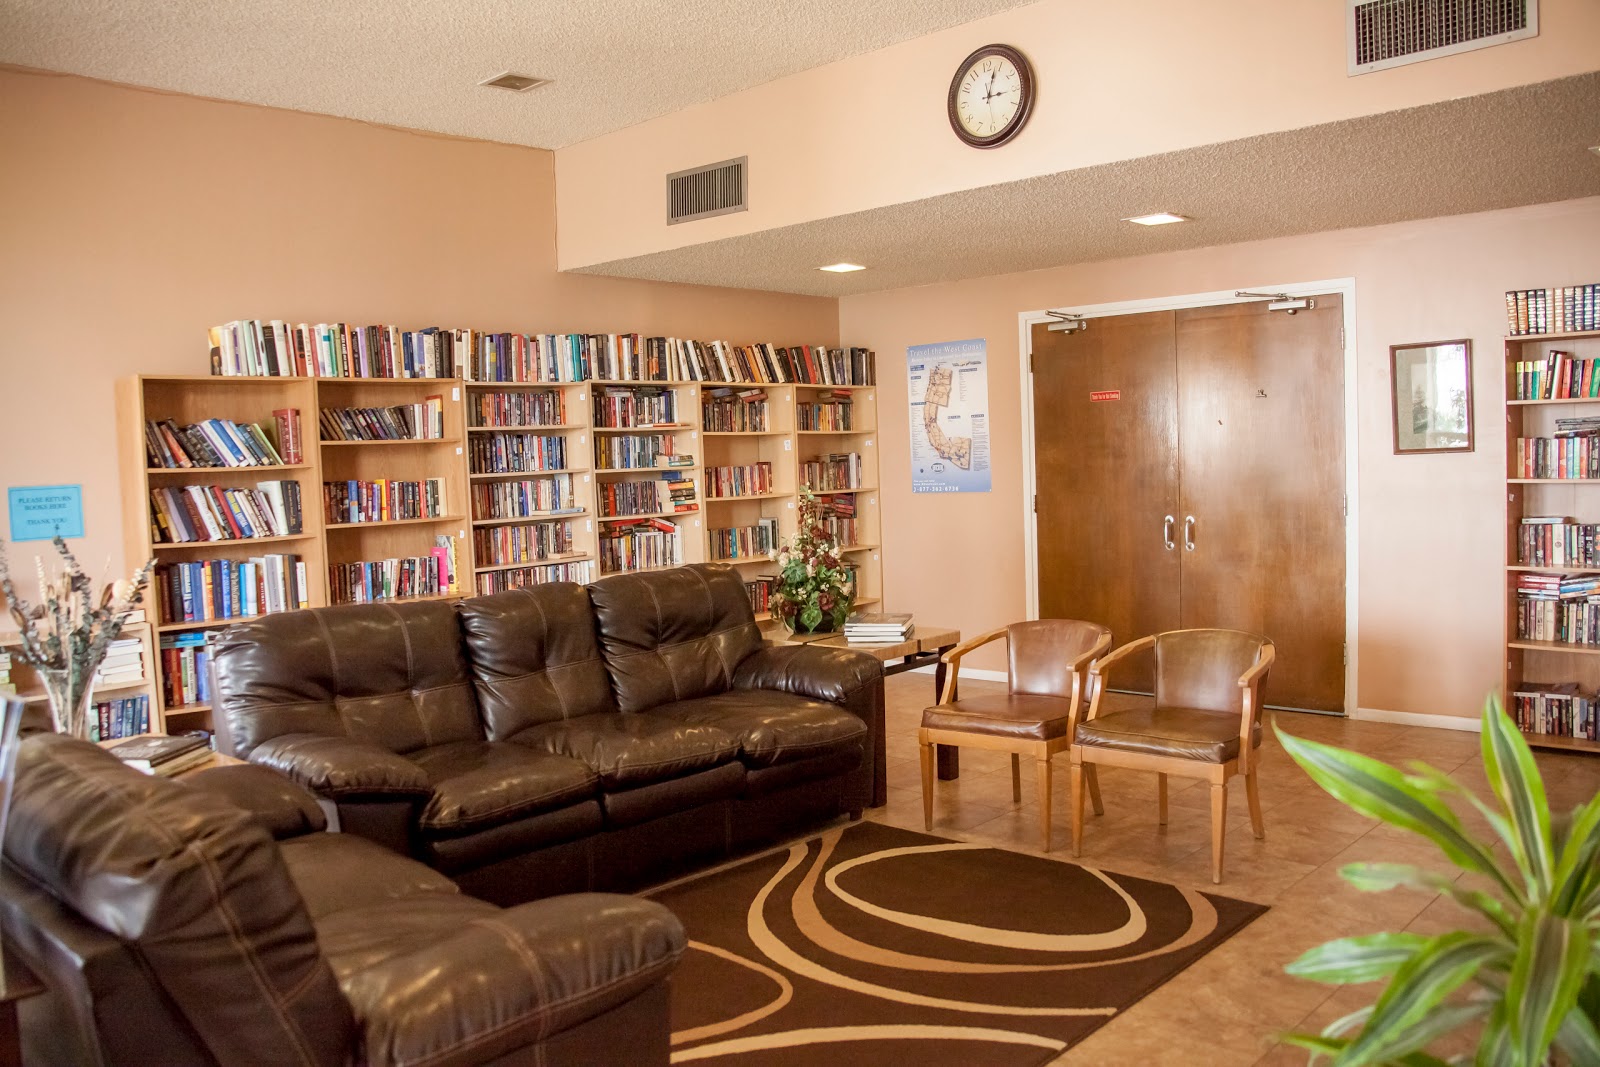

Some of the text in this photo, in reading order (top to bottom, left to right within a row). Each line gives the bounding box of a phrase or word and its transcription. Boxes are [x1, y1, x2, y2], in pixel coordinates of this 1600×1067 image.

[982, 60, 992, 72] 12
[998, 62, 1003, 72] 1
[970, 70, 979, 82] 11
[1006, 69, 1016, 80] 2
[962, 82, 972, 94] 10
[1011, 84, 1020, 92] 3
[965, 114, 974, 124] 8
[1002, 114, 1009, 125] 5
[977, 122, 983, 132] 7
[990, 122, 996, 133] 6
[962, 343, 982, 351] Coast
